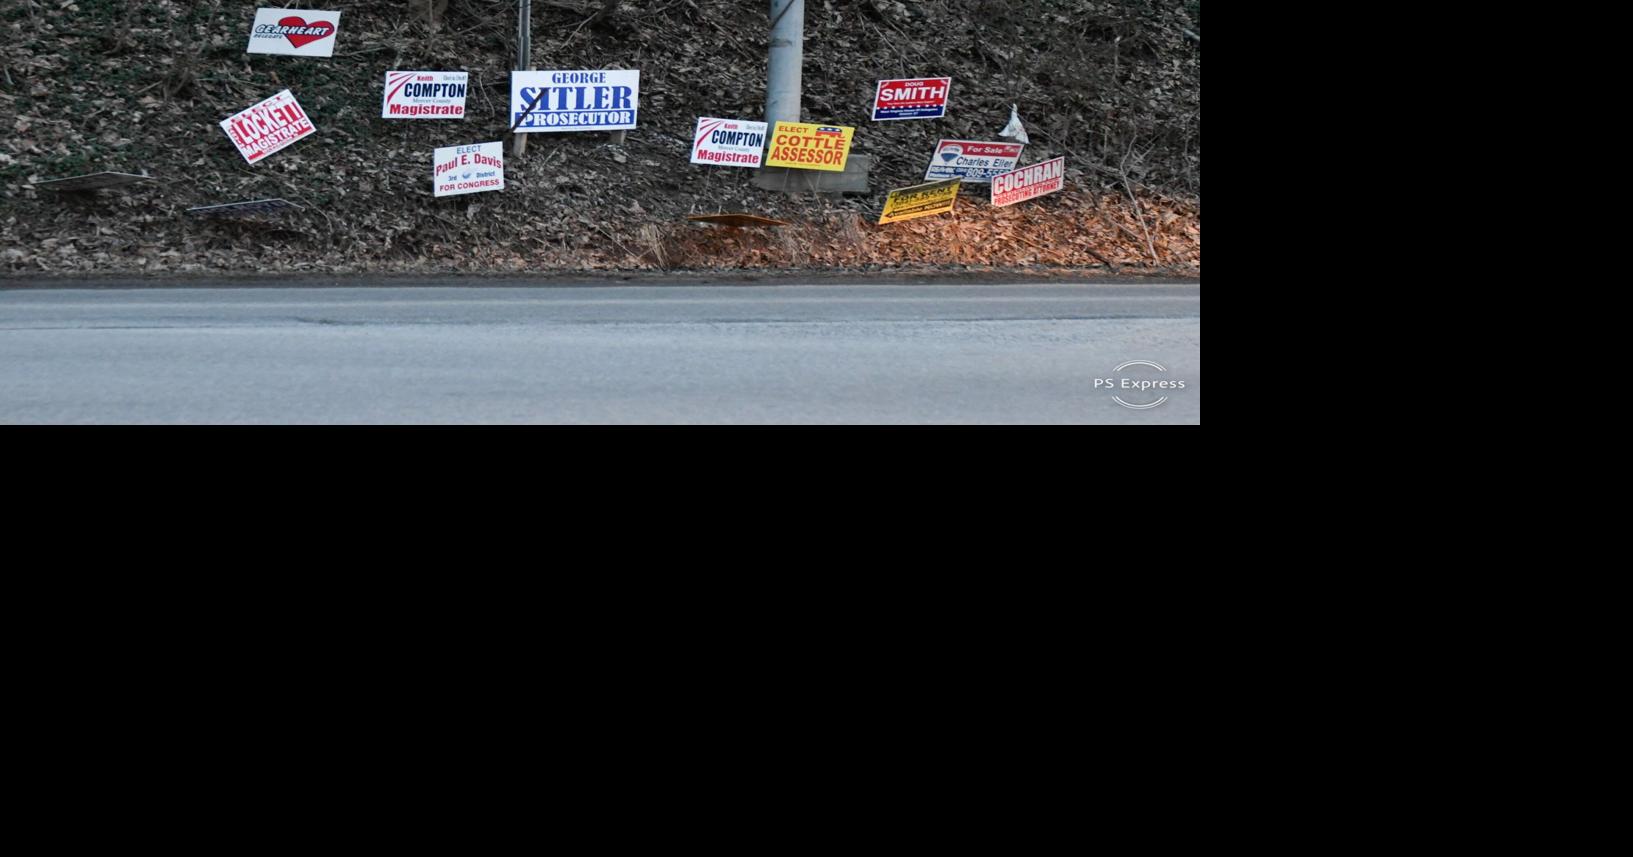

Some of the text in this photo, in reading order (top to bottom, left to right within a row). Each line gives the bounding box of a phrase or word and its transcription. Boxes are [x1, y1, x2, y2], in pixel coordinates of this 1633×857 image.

[255, 24, 329, 36] GEARHEART
[552, 72, 606, 84] GEORGE
[404, 82, 465, 98] COMPTON
[880, 86, 945, 102] SMITH
[520, 86, 632, 111] SITLER
[389, 104, 463, 116] Magistrate
[519, 111, 631, 126] PROSECUTOR
[242, 117, 310, 154] MAGISTRATE
[778, 125, 809, 134] ELECT
[711, 129, 763, 148] COMPTON
[776, 134, 846, 151] COTTLE
[456, 145, 481, 154] ELECT
[697, 149, 759, 164] Magistrate
[770, 145, 843, 166] ASSESSOR
[967, 145, 982, 153] For
[983, 146, 1003, 154] Sale
[436, 153, 502, 177] Paul E. Davis
[956, 156, 990, 167] Charles
[476, 170, 496, 178] District
[994, 160, 1062, 195] COCHRAN
[439, 179, 500, 192] FOR CONGRESS
[994, 178, 1061, 206] PROSECUTING ATTORNEY
